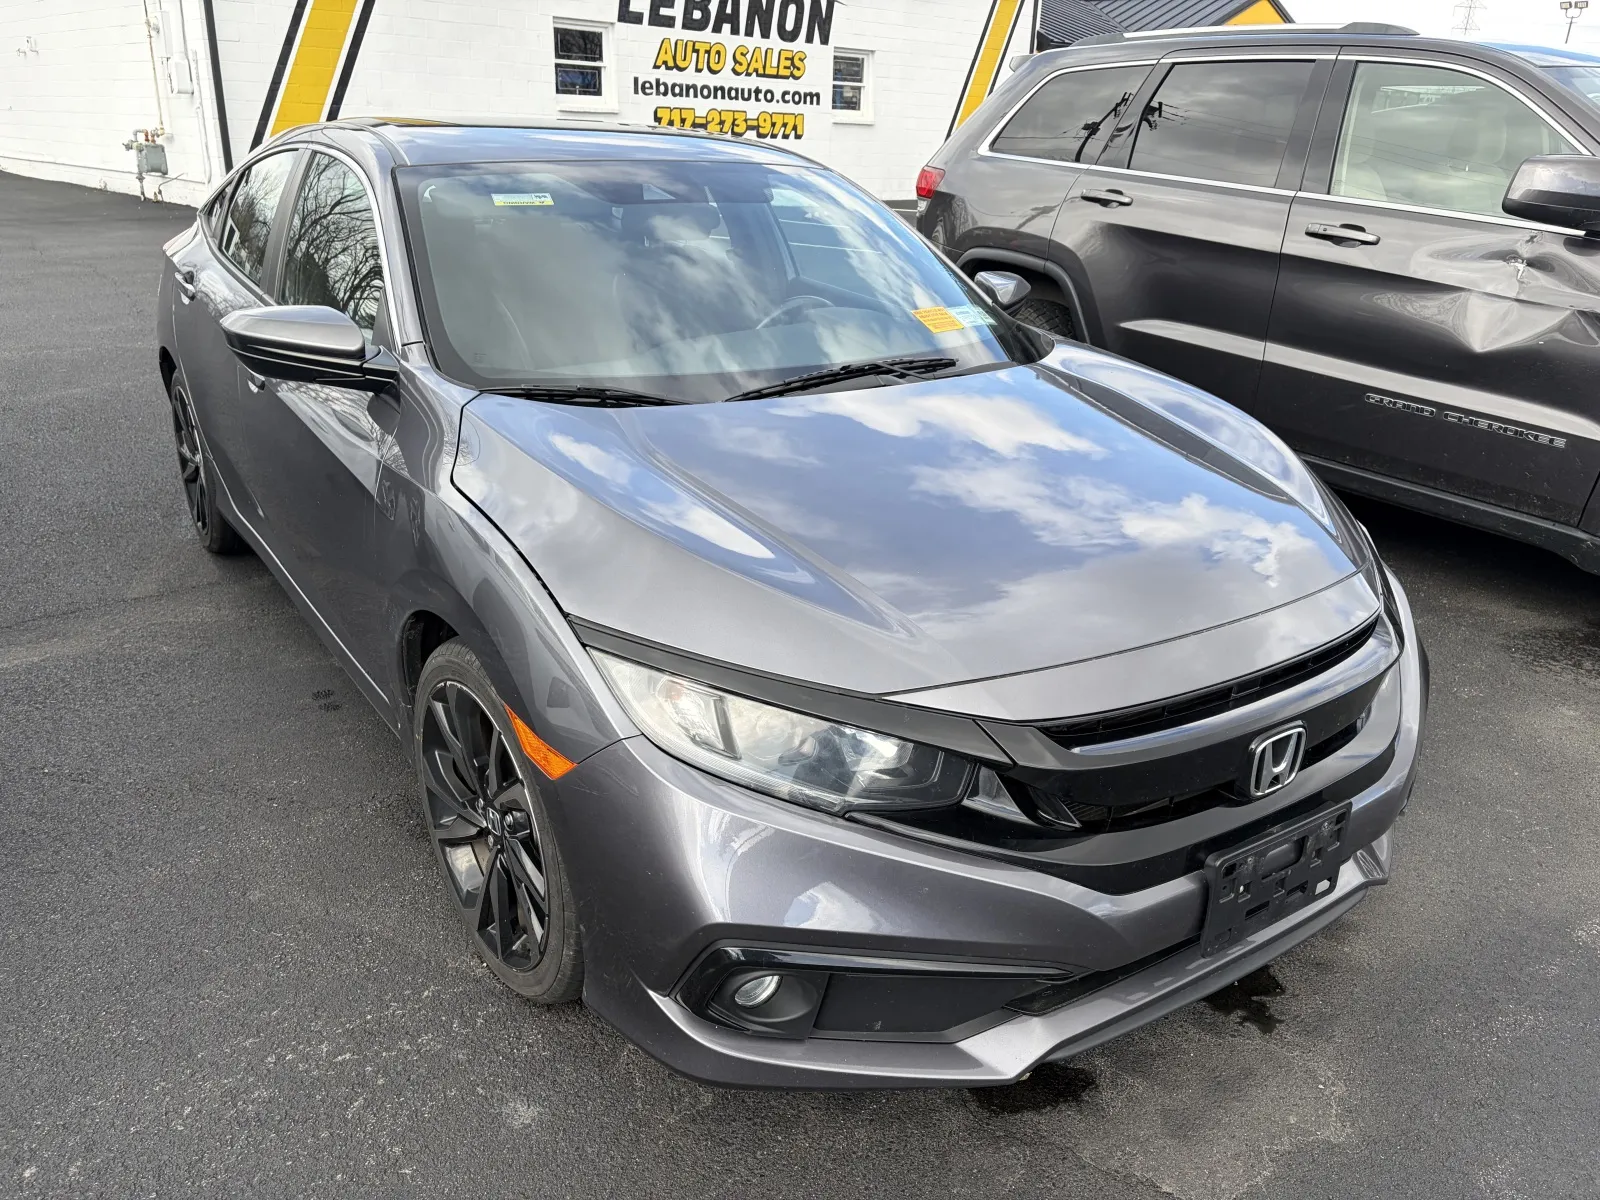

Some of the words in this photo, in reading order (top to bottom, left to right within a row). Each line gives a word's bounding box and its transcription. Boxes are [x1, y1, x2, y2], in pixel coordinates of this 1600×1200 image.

[653, 38, 727, 74] AUTO
[731, 45, 807, 80] SALES
[633, 76, 821, 106] lebanonauto.com
[654, 106, 804, 139] 717-273-9771
[1365, 393, 1436, 417] GRAND
[1443, 411, 1567, 448] CHEROKEE
